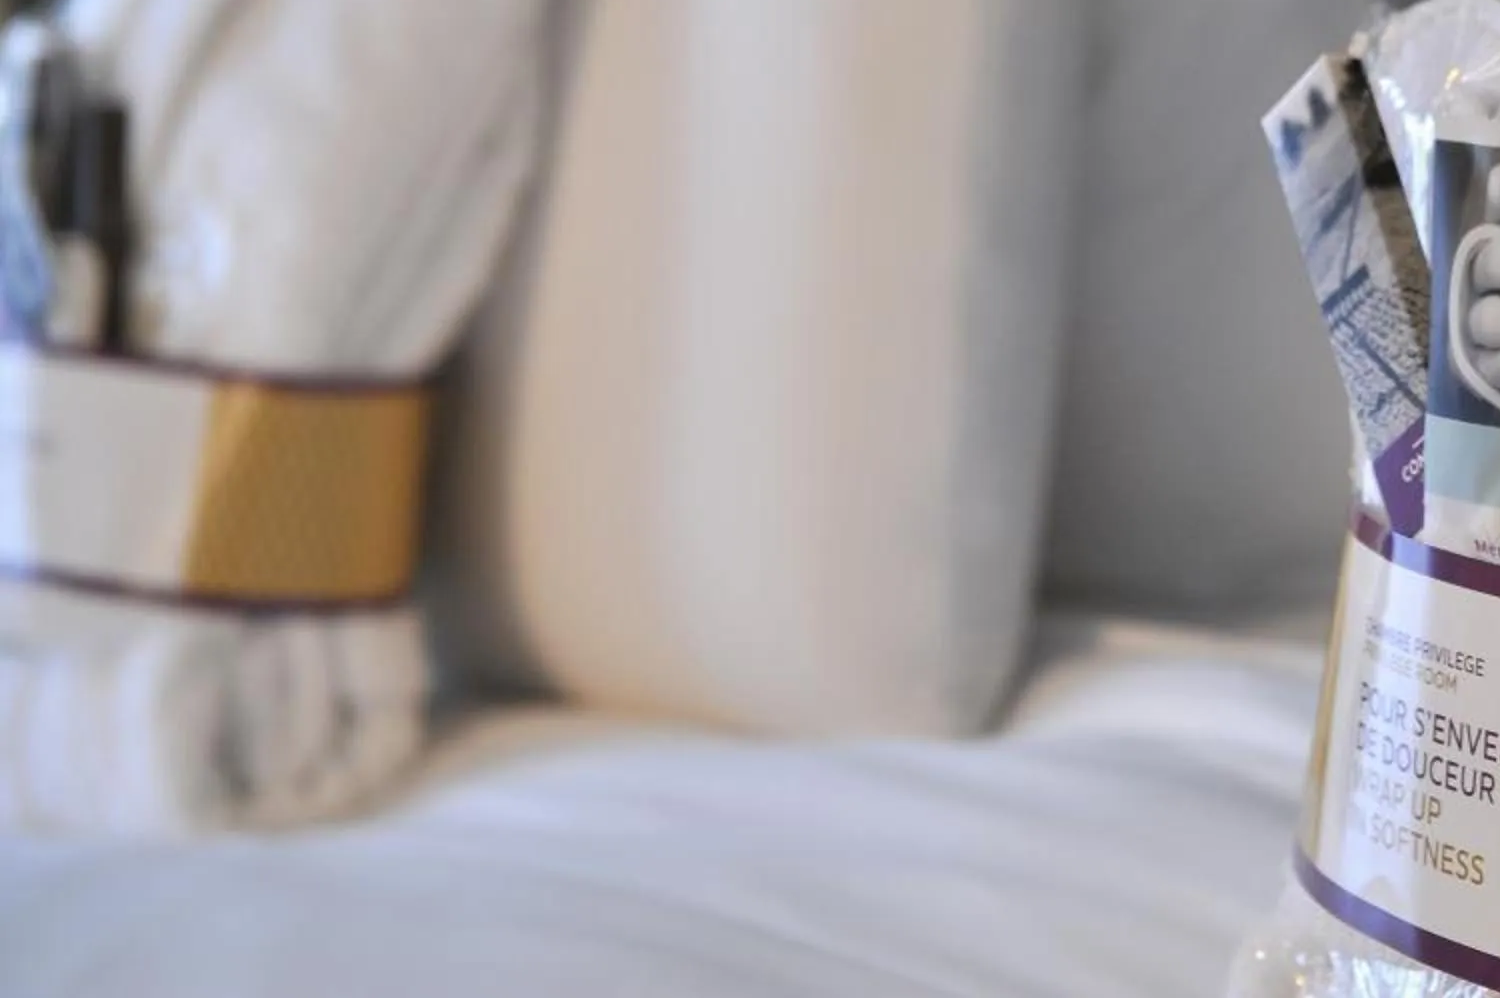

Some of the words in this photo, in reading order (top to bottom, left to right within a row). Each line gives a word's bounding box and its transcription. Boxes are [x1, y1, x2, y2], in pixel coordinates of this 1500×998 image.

[1355, 681, 1407, 731] POUR
[1356, 764, 1405, 807] RAP
[1410, 789, 1441, 825] UP
[1381, 734, 1496, 806] DOUCEUR
[1370, 811, 1486, 886] SOFTNESS
